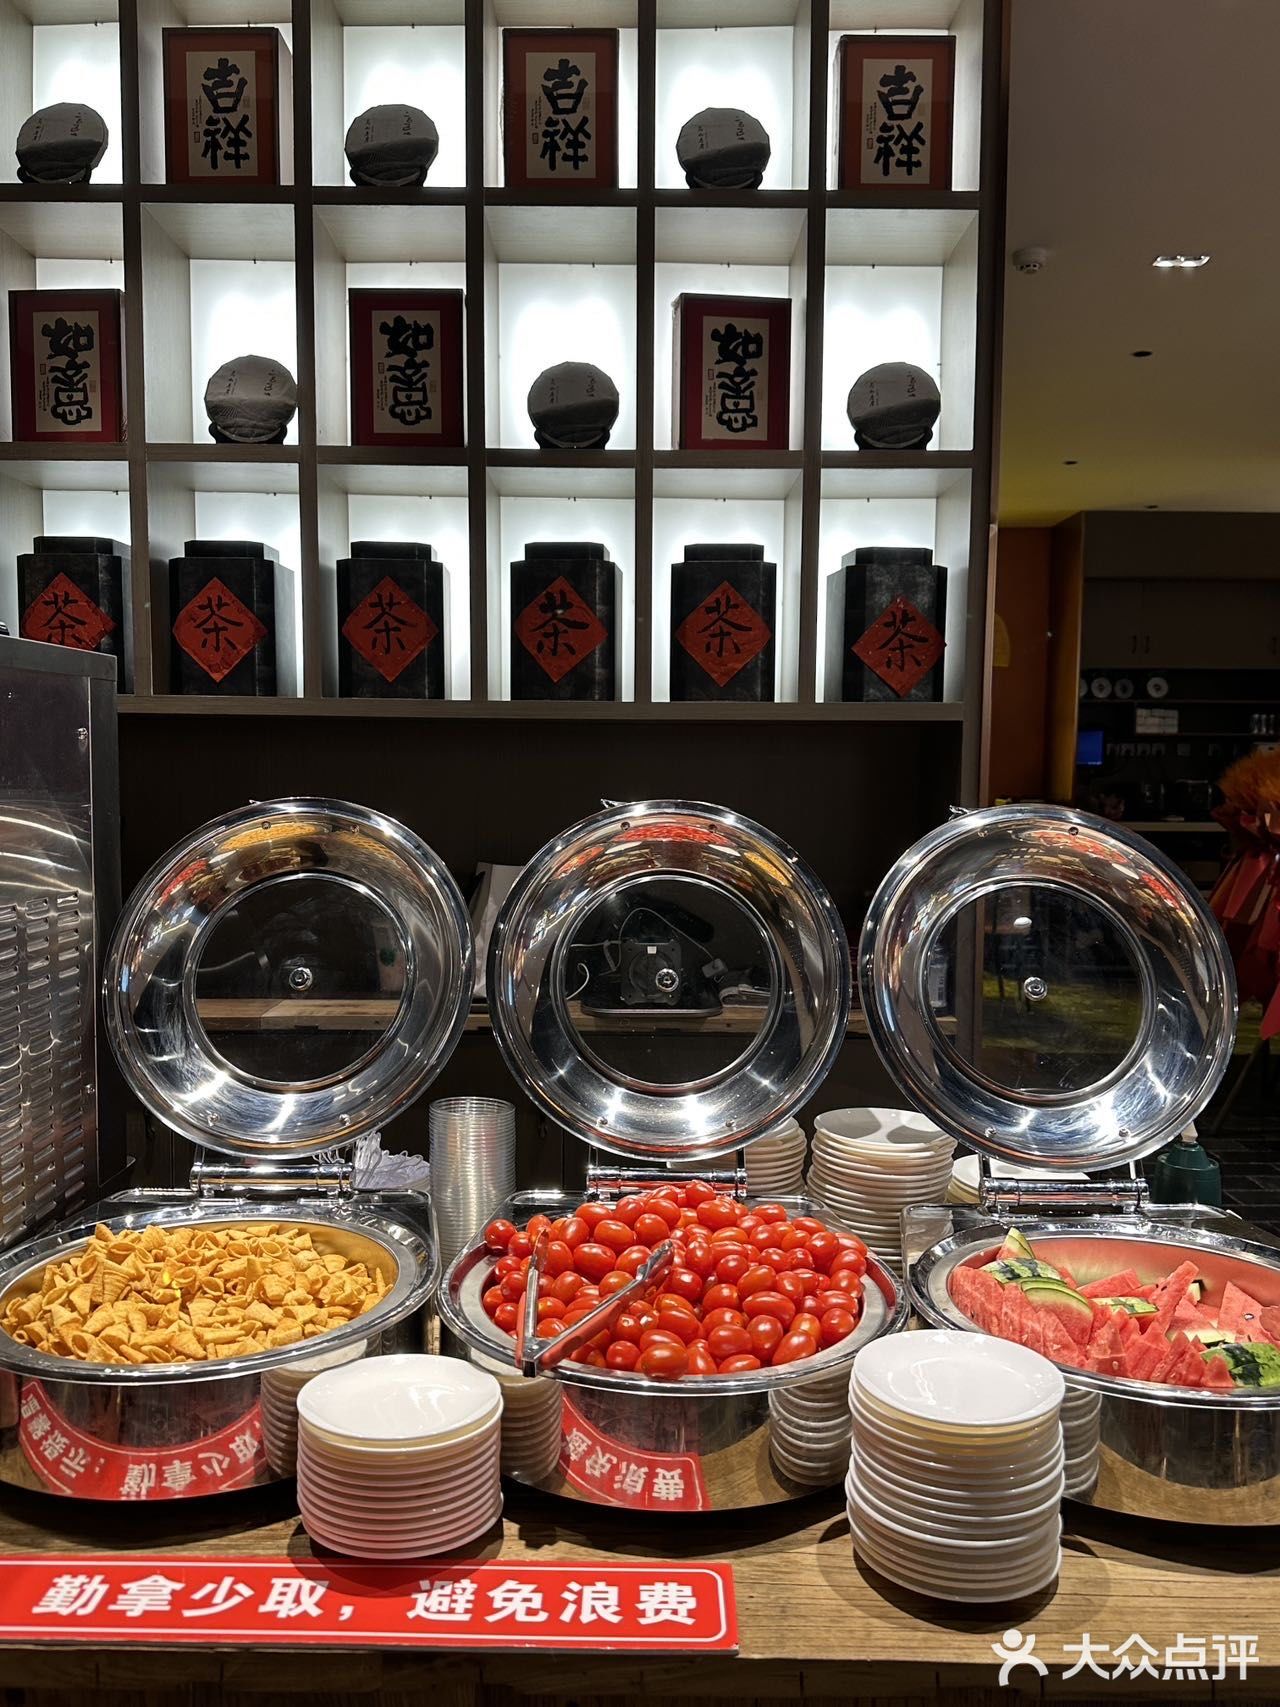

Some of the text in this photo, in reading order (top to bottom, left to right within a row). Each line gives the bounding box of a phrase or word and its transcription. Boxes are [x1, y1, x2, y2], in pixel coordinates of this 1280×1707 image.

[201, 57, 252, 170] 吉祥
[540, 58, 592, 171] 吉祥
[874, 65, 926, 176] 吉祥
[40, 591, 87, 645] 茶
[194, 596, 243, 653] 茶
[362, 591, 417, 656] 茶
[530, 590, 590, 657] 茶
[697, 595, 752, 658] 茶
[878, 608, 929, 673] 茶
